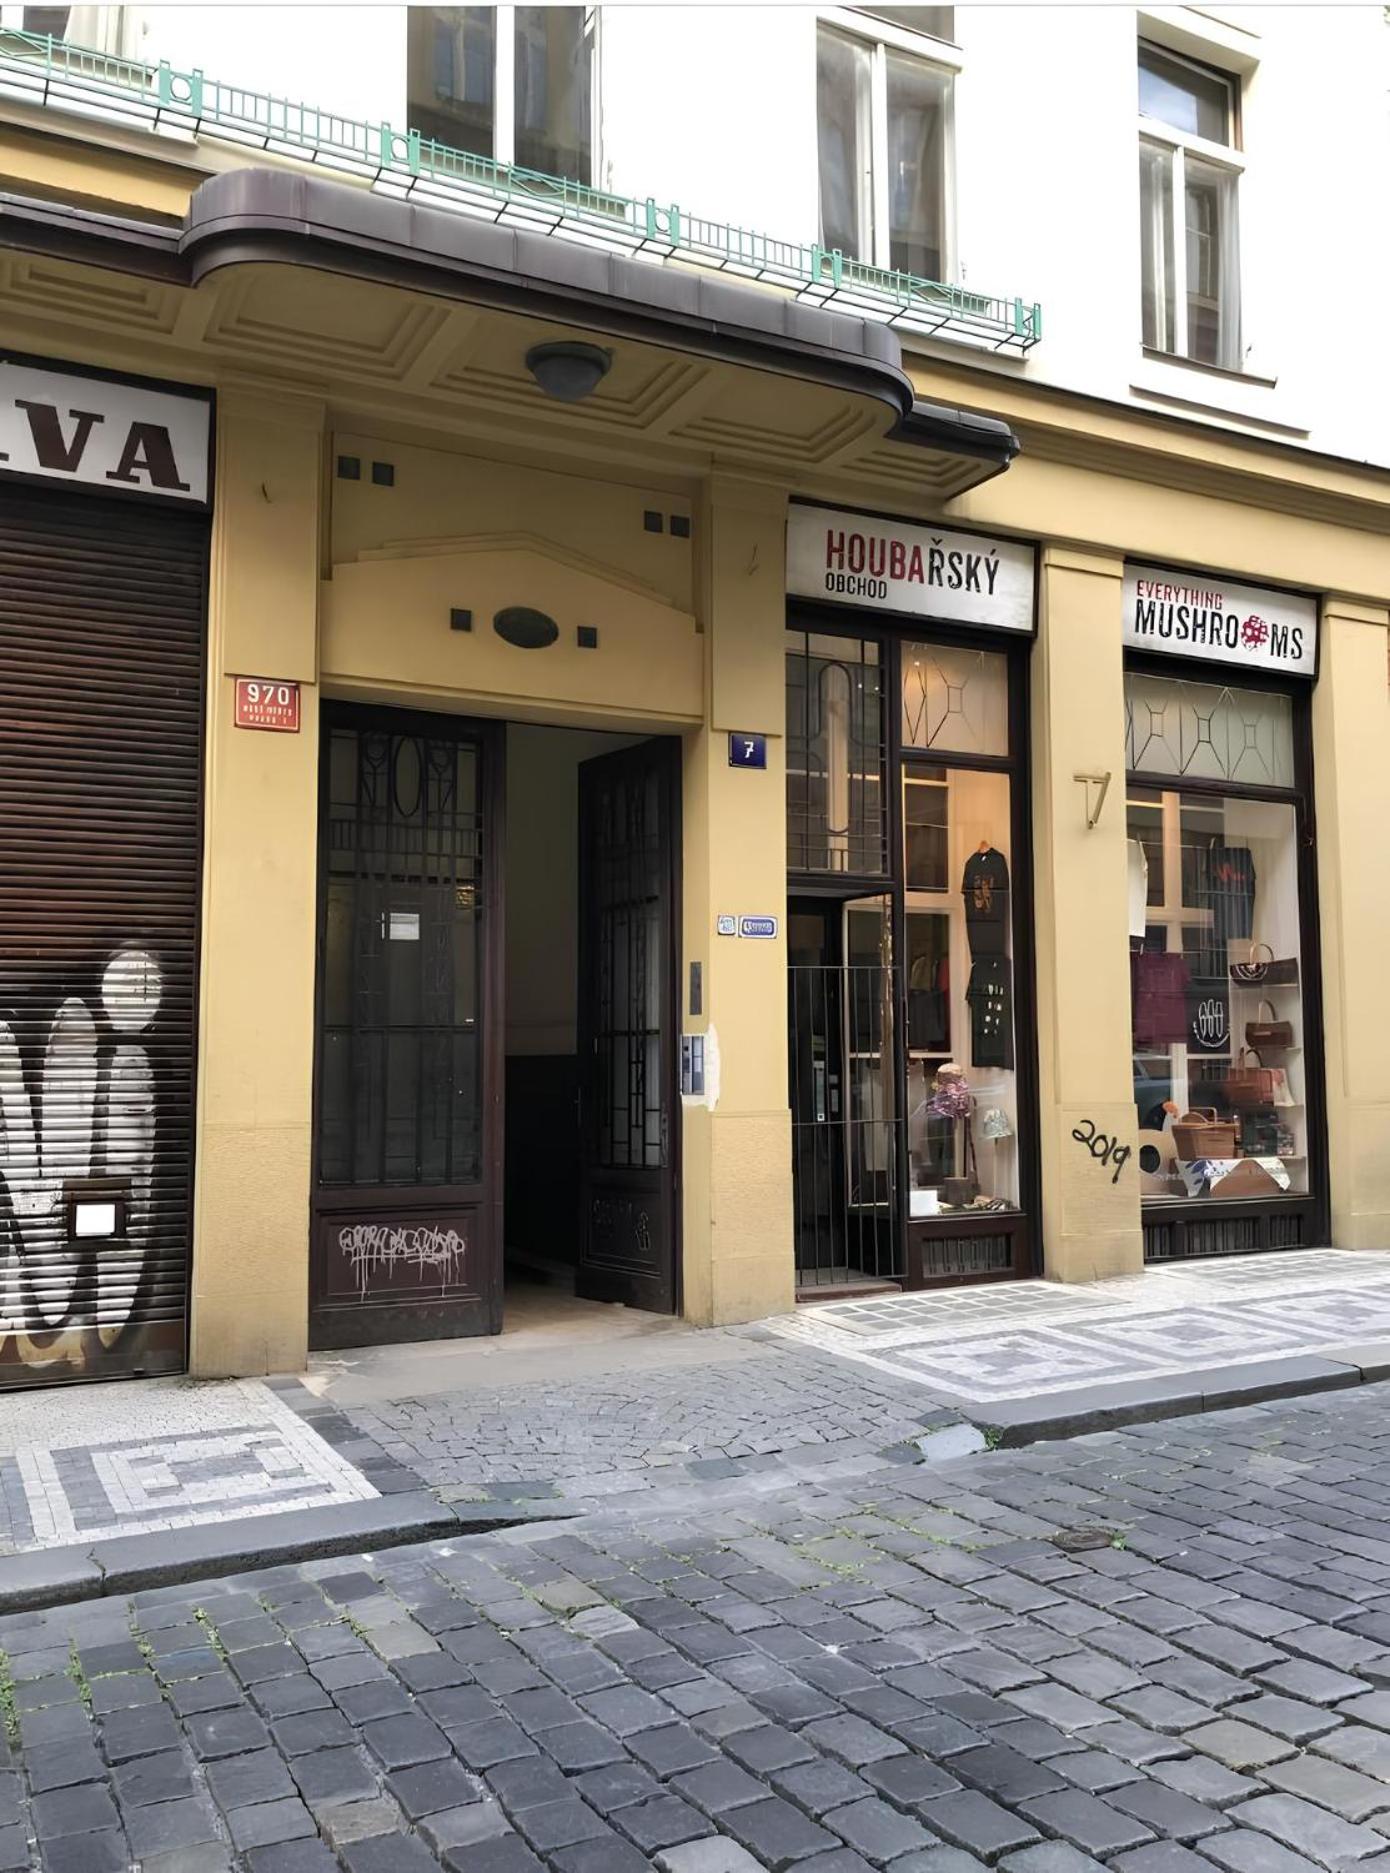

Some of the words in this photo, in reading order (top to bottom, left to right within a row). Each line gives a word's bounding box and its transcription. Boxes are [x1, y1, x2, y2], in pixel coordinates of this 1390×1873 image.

[0, 399, 190, 492] VA
[826, 529, 999, 595] HOUBAŘSKÝ
[825, 572, 887, 600] OBCHOD
[1136, 579, 1224, 610] EVERYTHING
[1135, 598, 1303, 660] MUSHROMS
[247, 683, 289, 705] 970
[743, 740, 754, 759] 7
[1072, 1119, 1131, 1184] 2019
